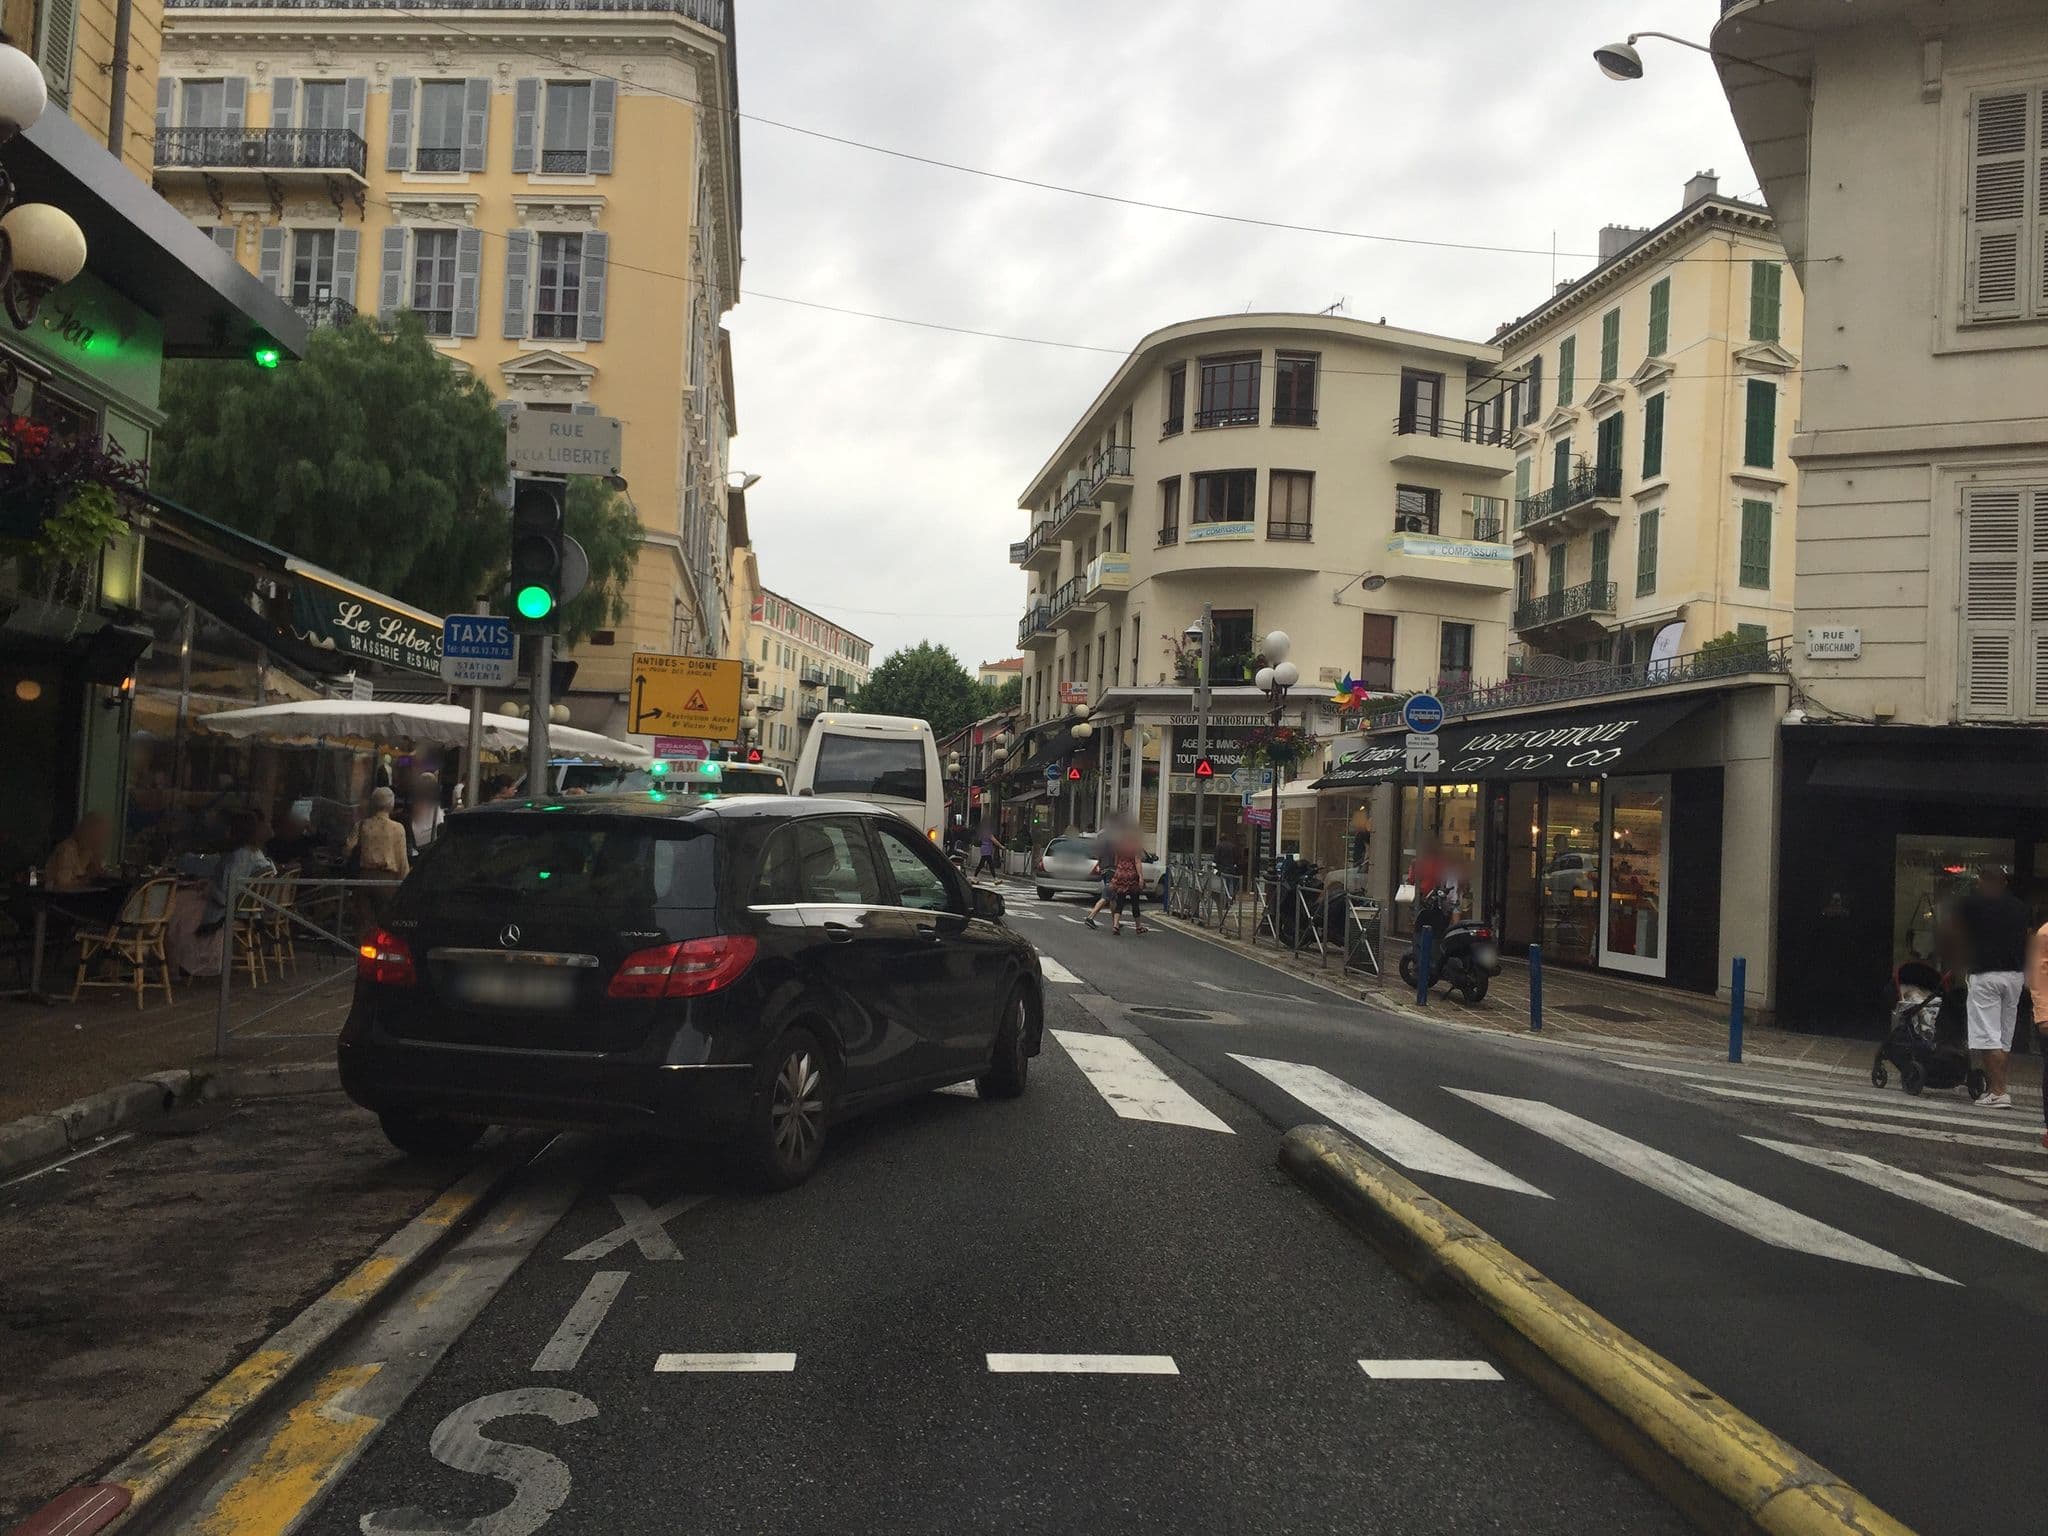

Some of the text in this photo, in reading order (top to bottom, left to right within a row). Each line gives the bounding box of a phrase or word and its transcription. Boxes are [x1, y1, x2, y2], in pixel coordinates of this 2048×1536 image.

[549, 423, 584, 437] RUE
[1441, 544, 1499, 558] COMPASSUR
[333, 601, 370, 633] Le
[450, 623, 510, 645] TAXIS
[1822, 631, 1845, 640] RUE
[350, 634, 441, 674] BRASSERIE RESTAUR
[1810, 643, 1856, 653] LONGCHAMP
[456, 661, 500, 672] STATION
[636, 657, 679, 668] ANTIBES
[688, 660, 719, 671] DIGNE
[454, 671, 502, 681] MAGENTA
[1169, 714, 1266, 726] SOCOPO IMMOBILIER
[1181, 738, 1214, 749] AGECE
[1209, 753, 1247, 766] TRANSAC
[669, 761, 698, 773] TAXI
